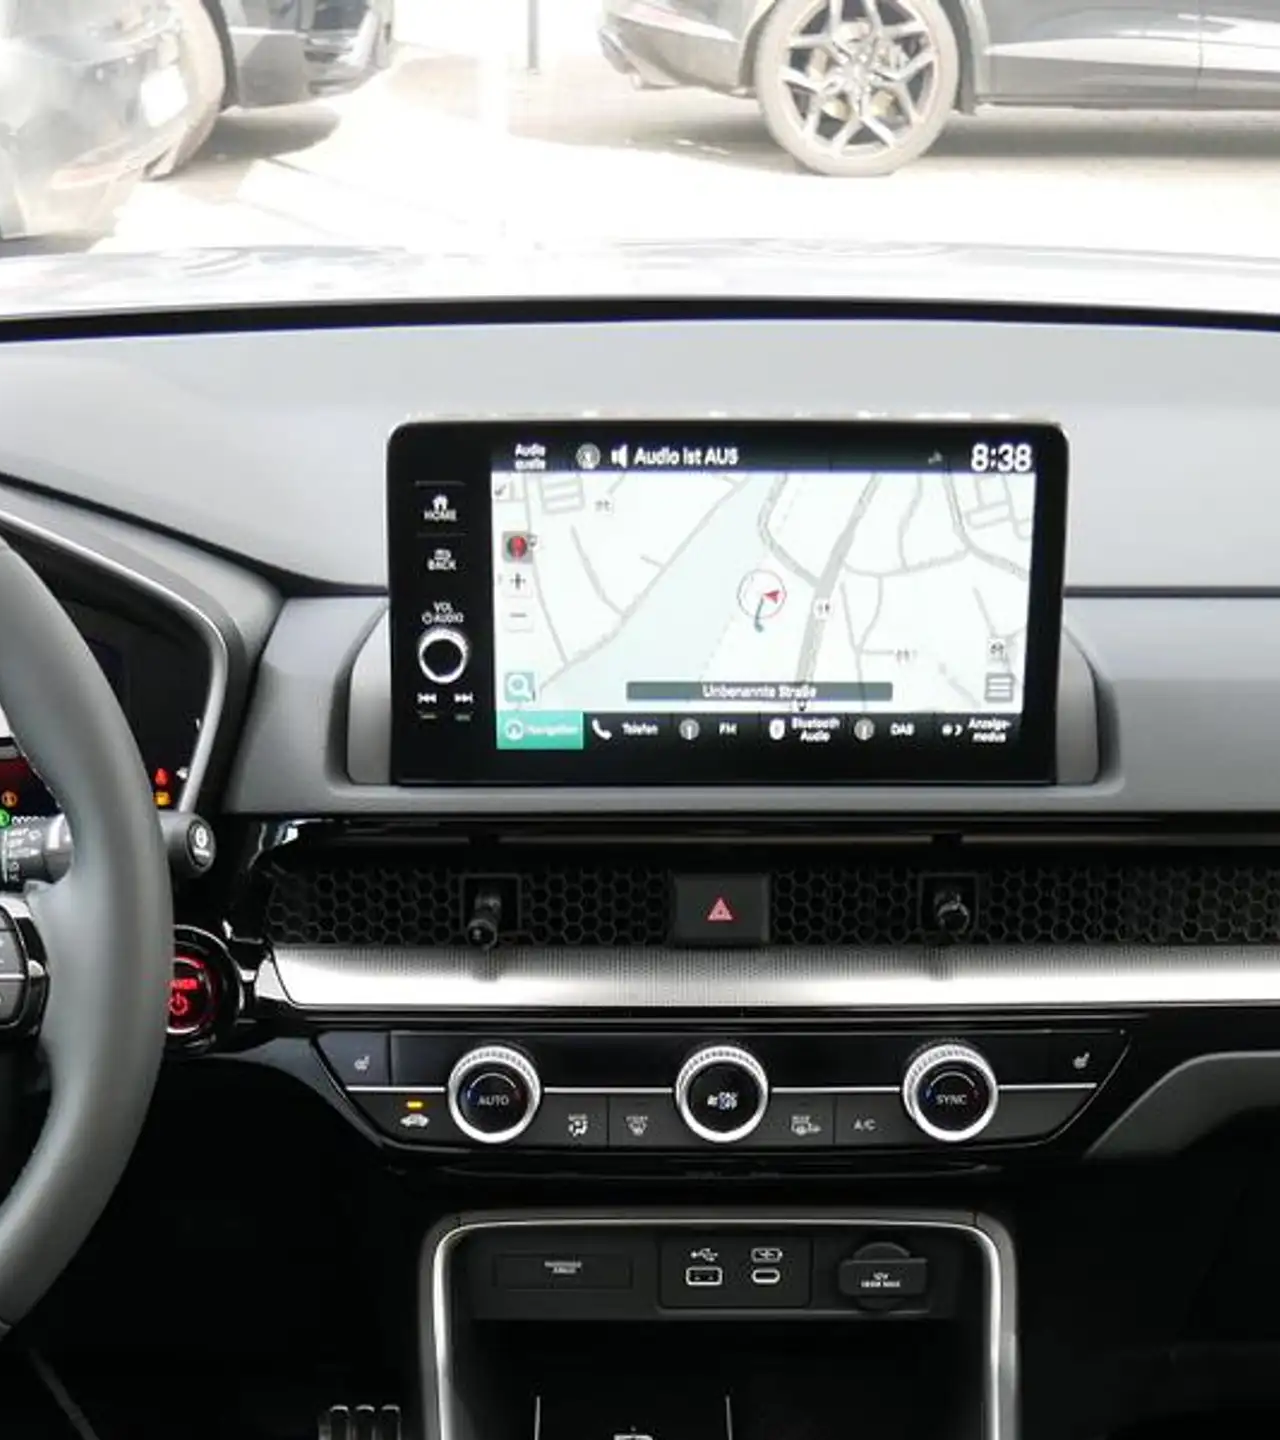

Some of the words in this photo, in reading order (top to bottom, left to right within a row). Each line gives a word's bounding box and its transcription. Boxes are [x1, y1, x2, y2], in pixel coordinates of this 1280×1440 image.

[634, 446, 680, 465] Audio
[682, 446, 702, 465] ist
[705, 447, 739, 465] AUS
[971, 443, 1032, 472] 8:38
[478, 1094, 510, 1106] AUTO
[936, 1094, 968, 1105] SYNC
